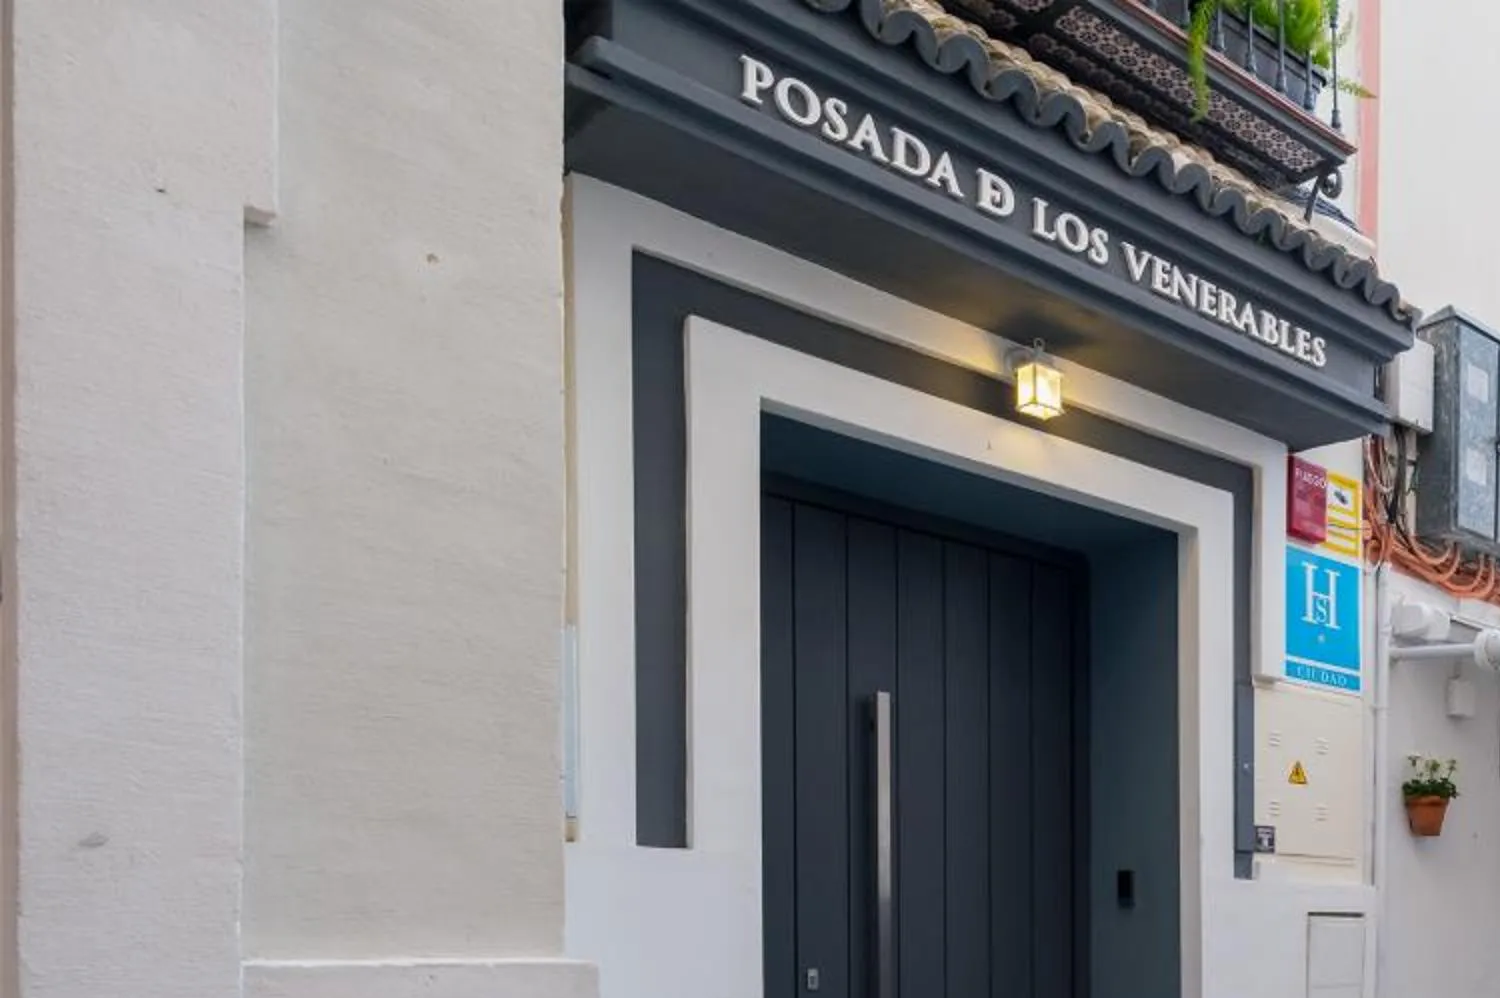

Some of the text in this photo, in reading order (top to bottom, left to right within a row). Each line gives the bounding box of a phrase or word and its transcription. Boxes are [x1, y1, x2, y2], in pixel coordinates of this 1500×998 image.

[739, 54, 964, 198] POSADA
[1032, 197, 1109, 265] LOS
[1121, 242, 1327, 367] VENERABLES
